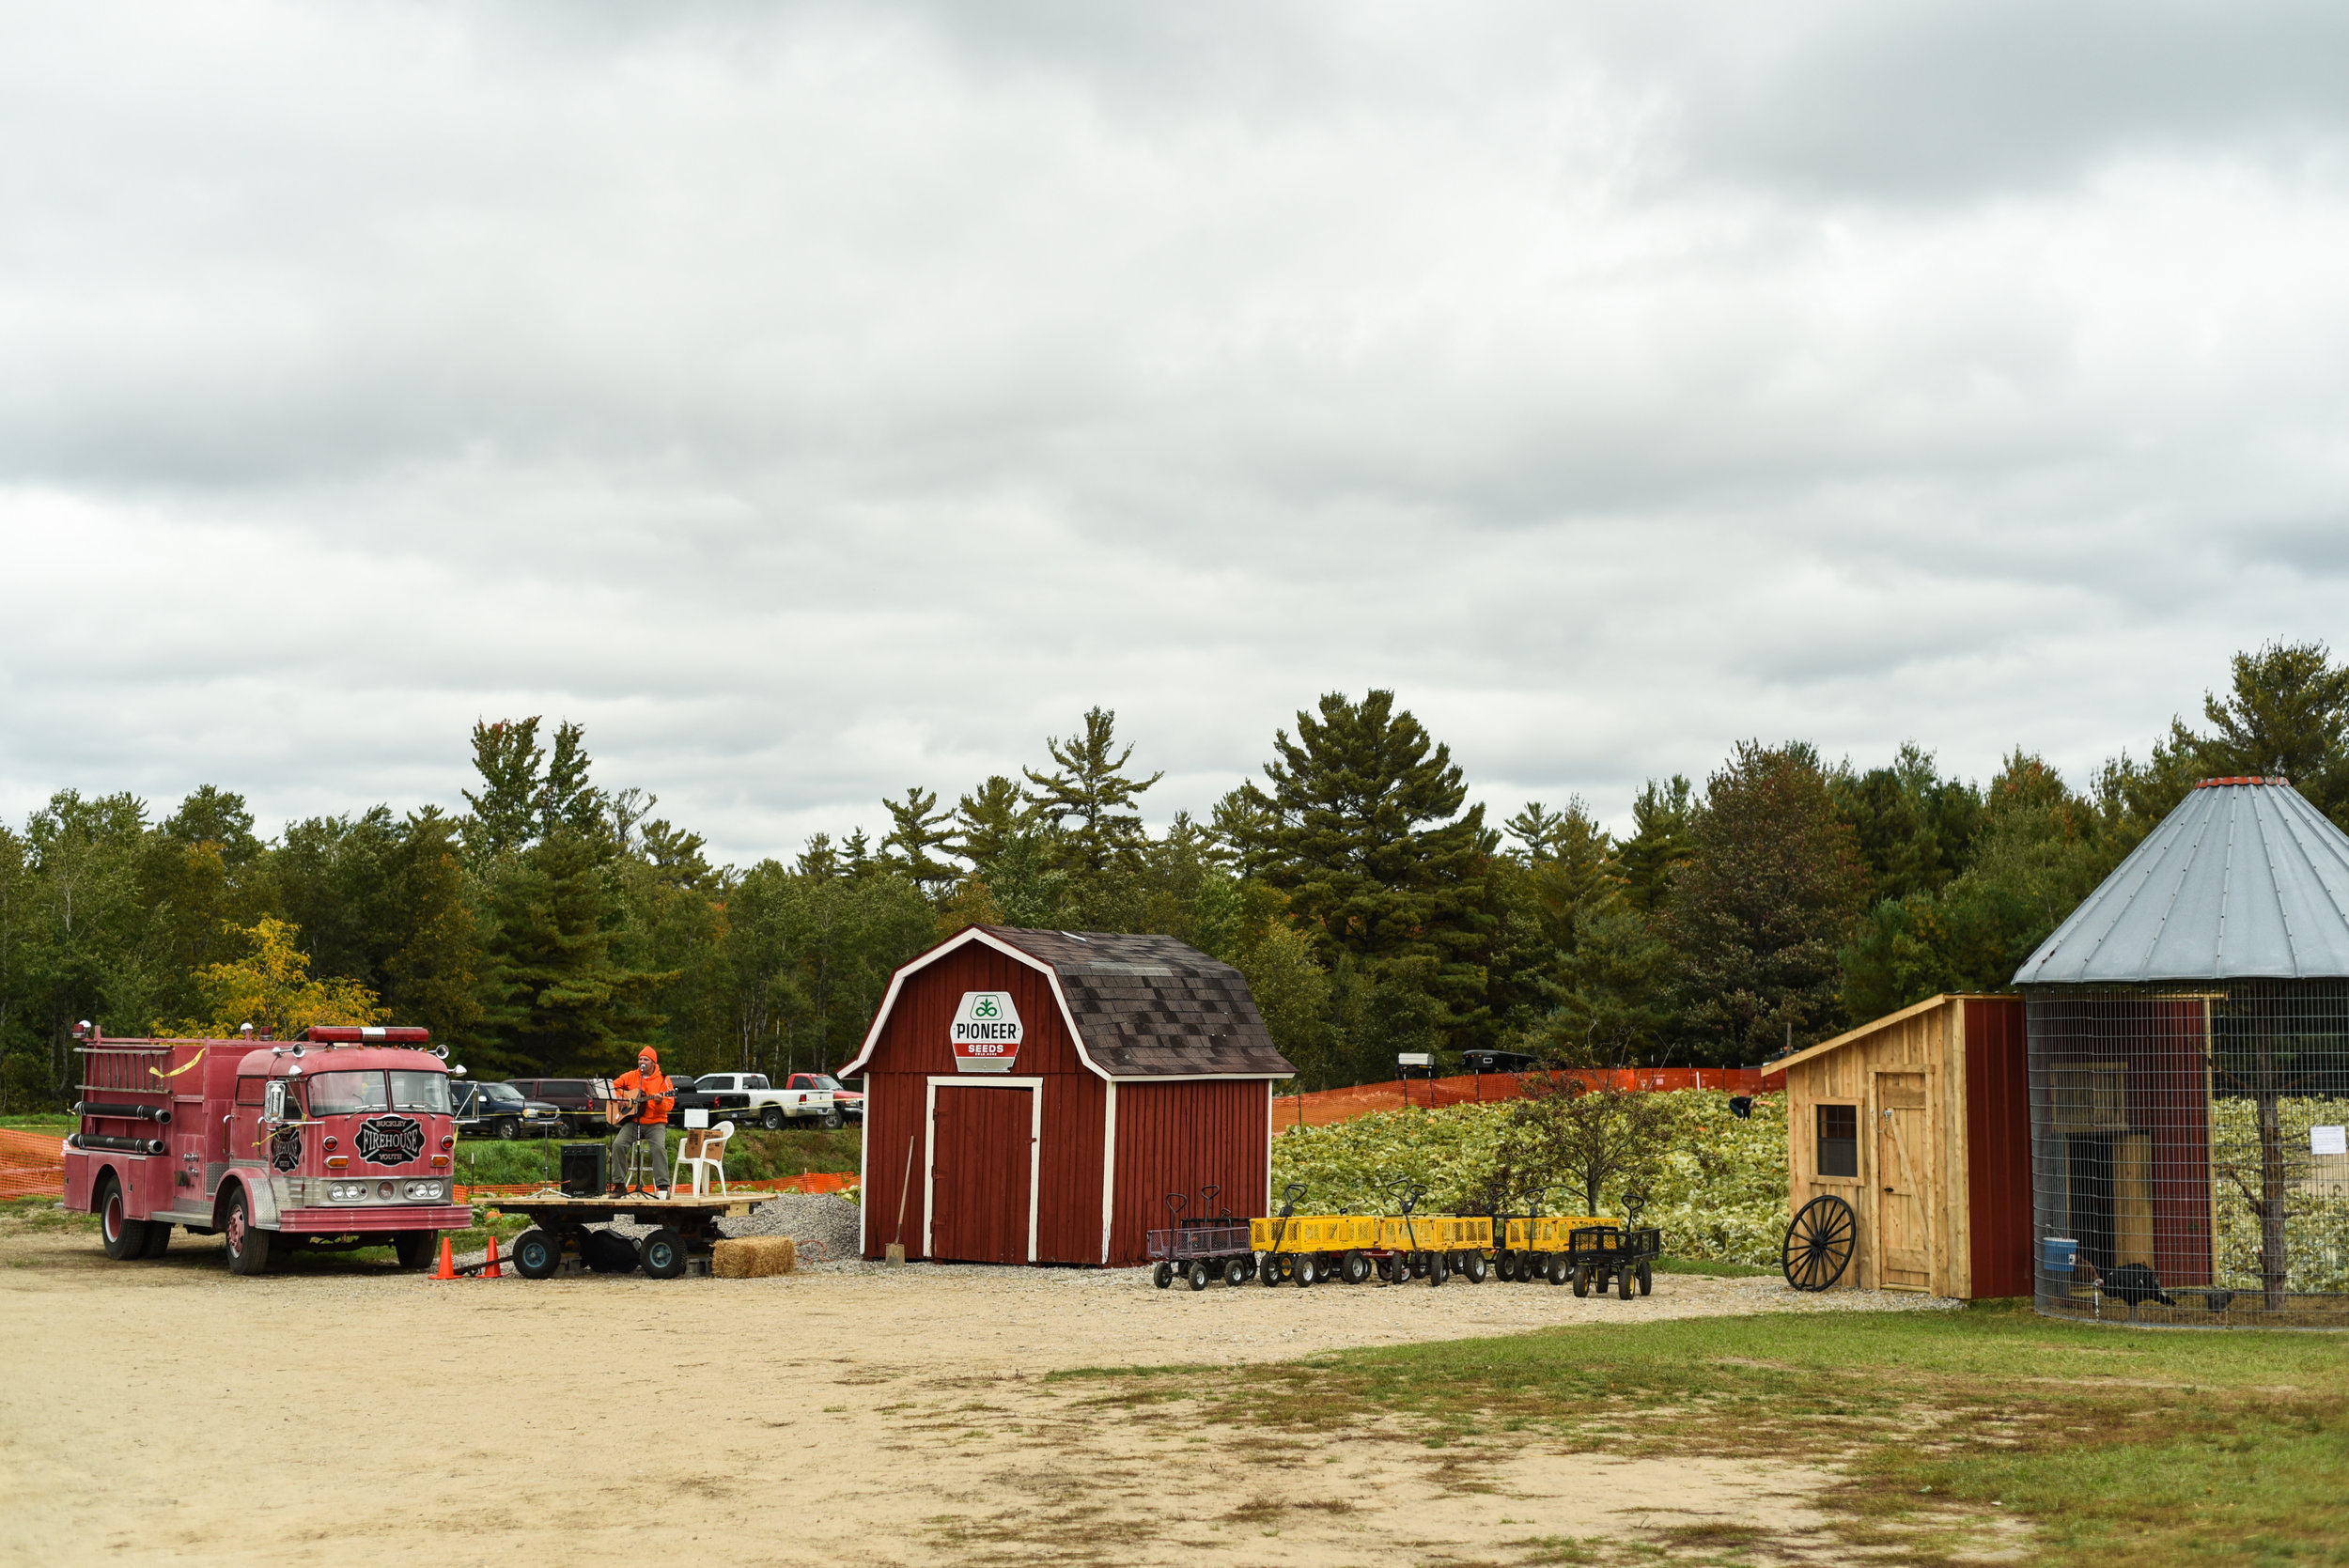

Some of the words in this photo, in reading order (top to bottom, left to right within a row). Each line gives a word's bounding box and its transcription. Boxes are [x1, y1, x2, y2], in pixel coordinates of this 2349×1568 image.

[956, 1023, 1017, 1039] PIONEER
[968, 1044, 1004, 1052] SEEDS
[363, 1128, 418, 1154] FIREHOUSE
